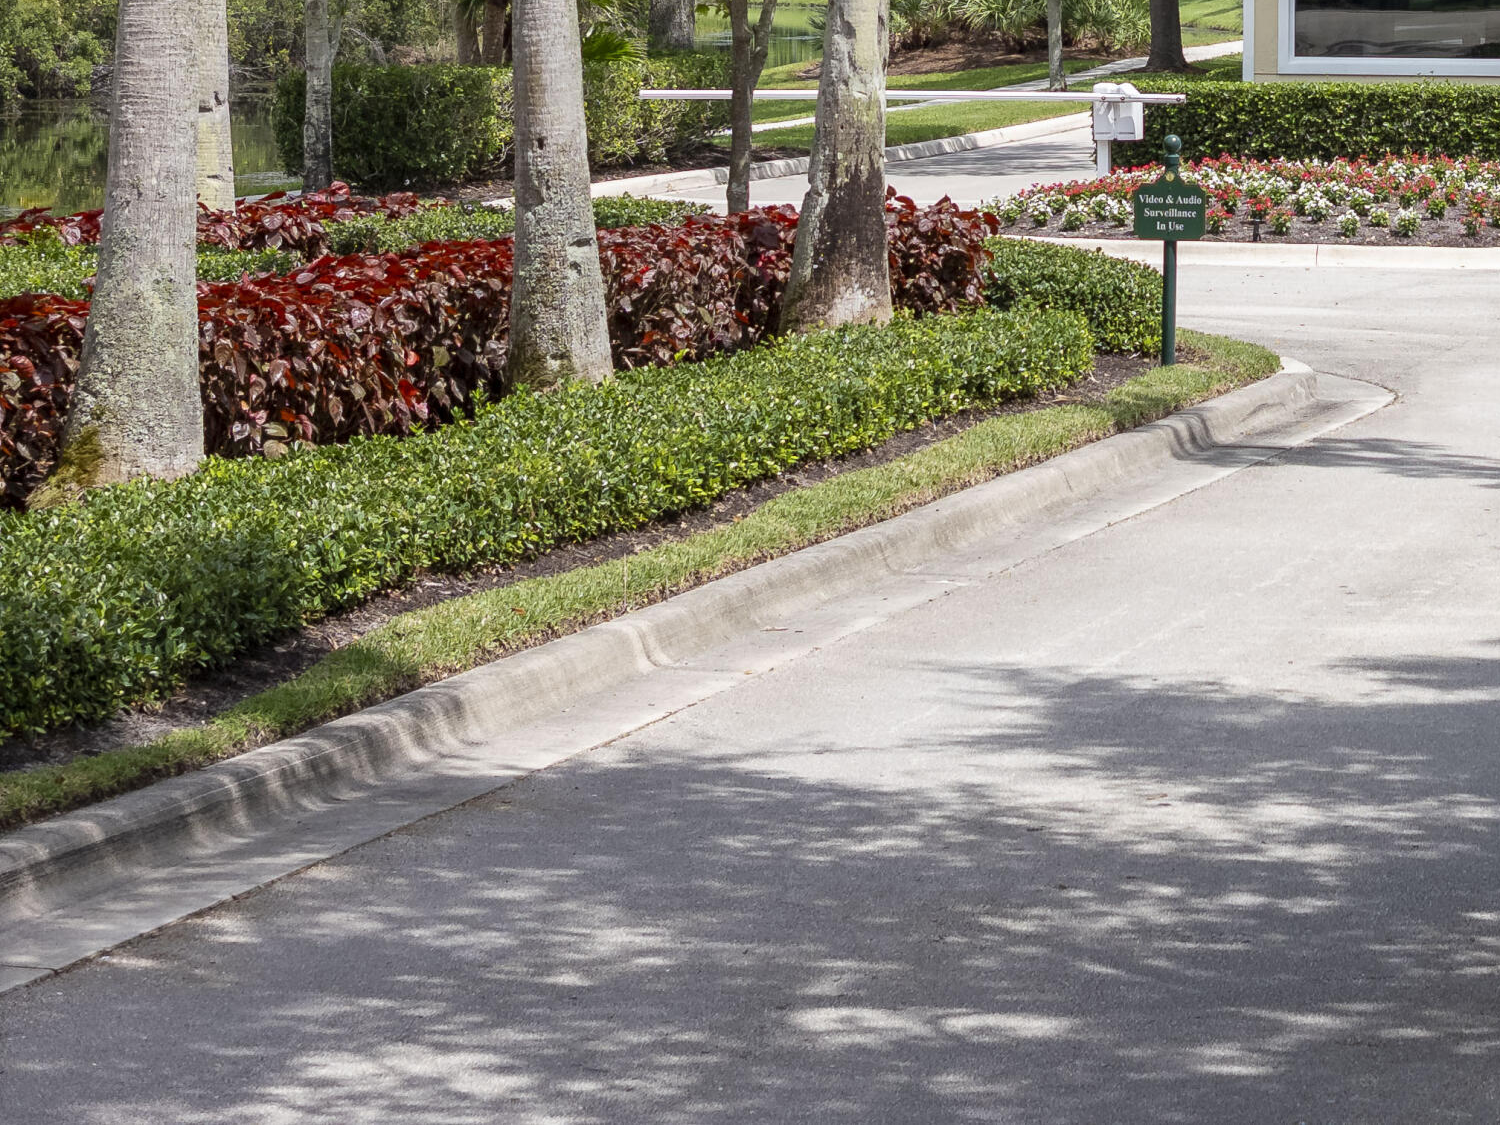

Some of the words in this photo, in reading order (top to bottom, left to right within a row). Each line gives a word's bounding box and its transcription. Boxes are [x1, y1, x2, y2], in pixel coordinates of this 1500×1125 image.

[1138, 194, 1164, 204] Video
[1165, 194, 1174, 204] &
[1175, 195, 1202, 205] Audio
[1143, 207, 1197, 218] Surveillance
[1156, 221, 1166, 231] In
[1168, 221, 1185, 231] Use
